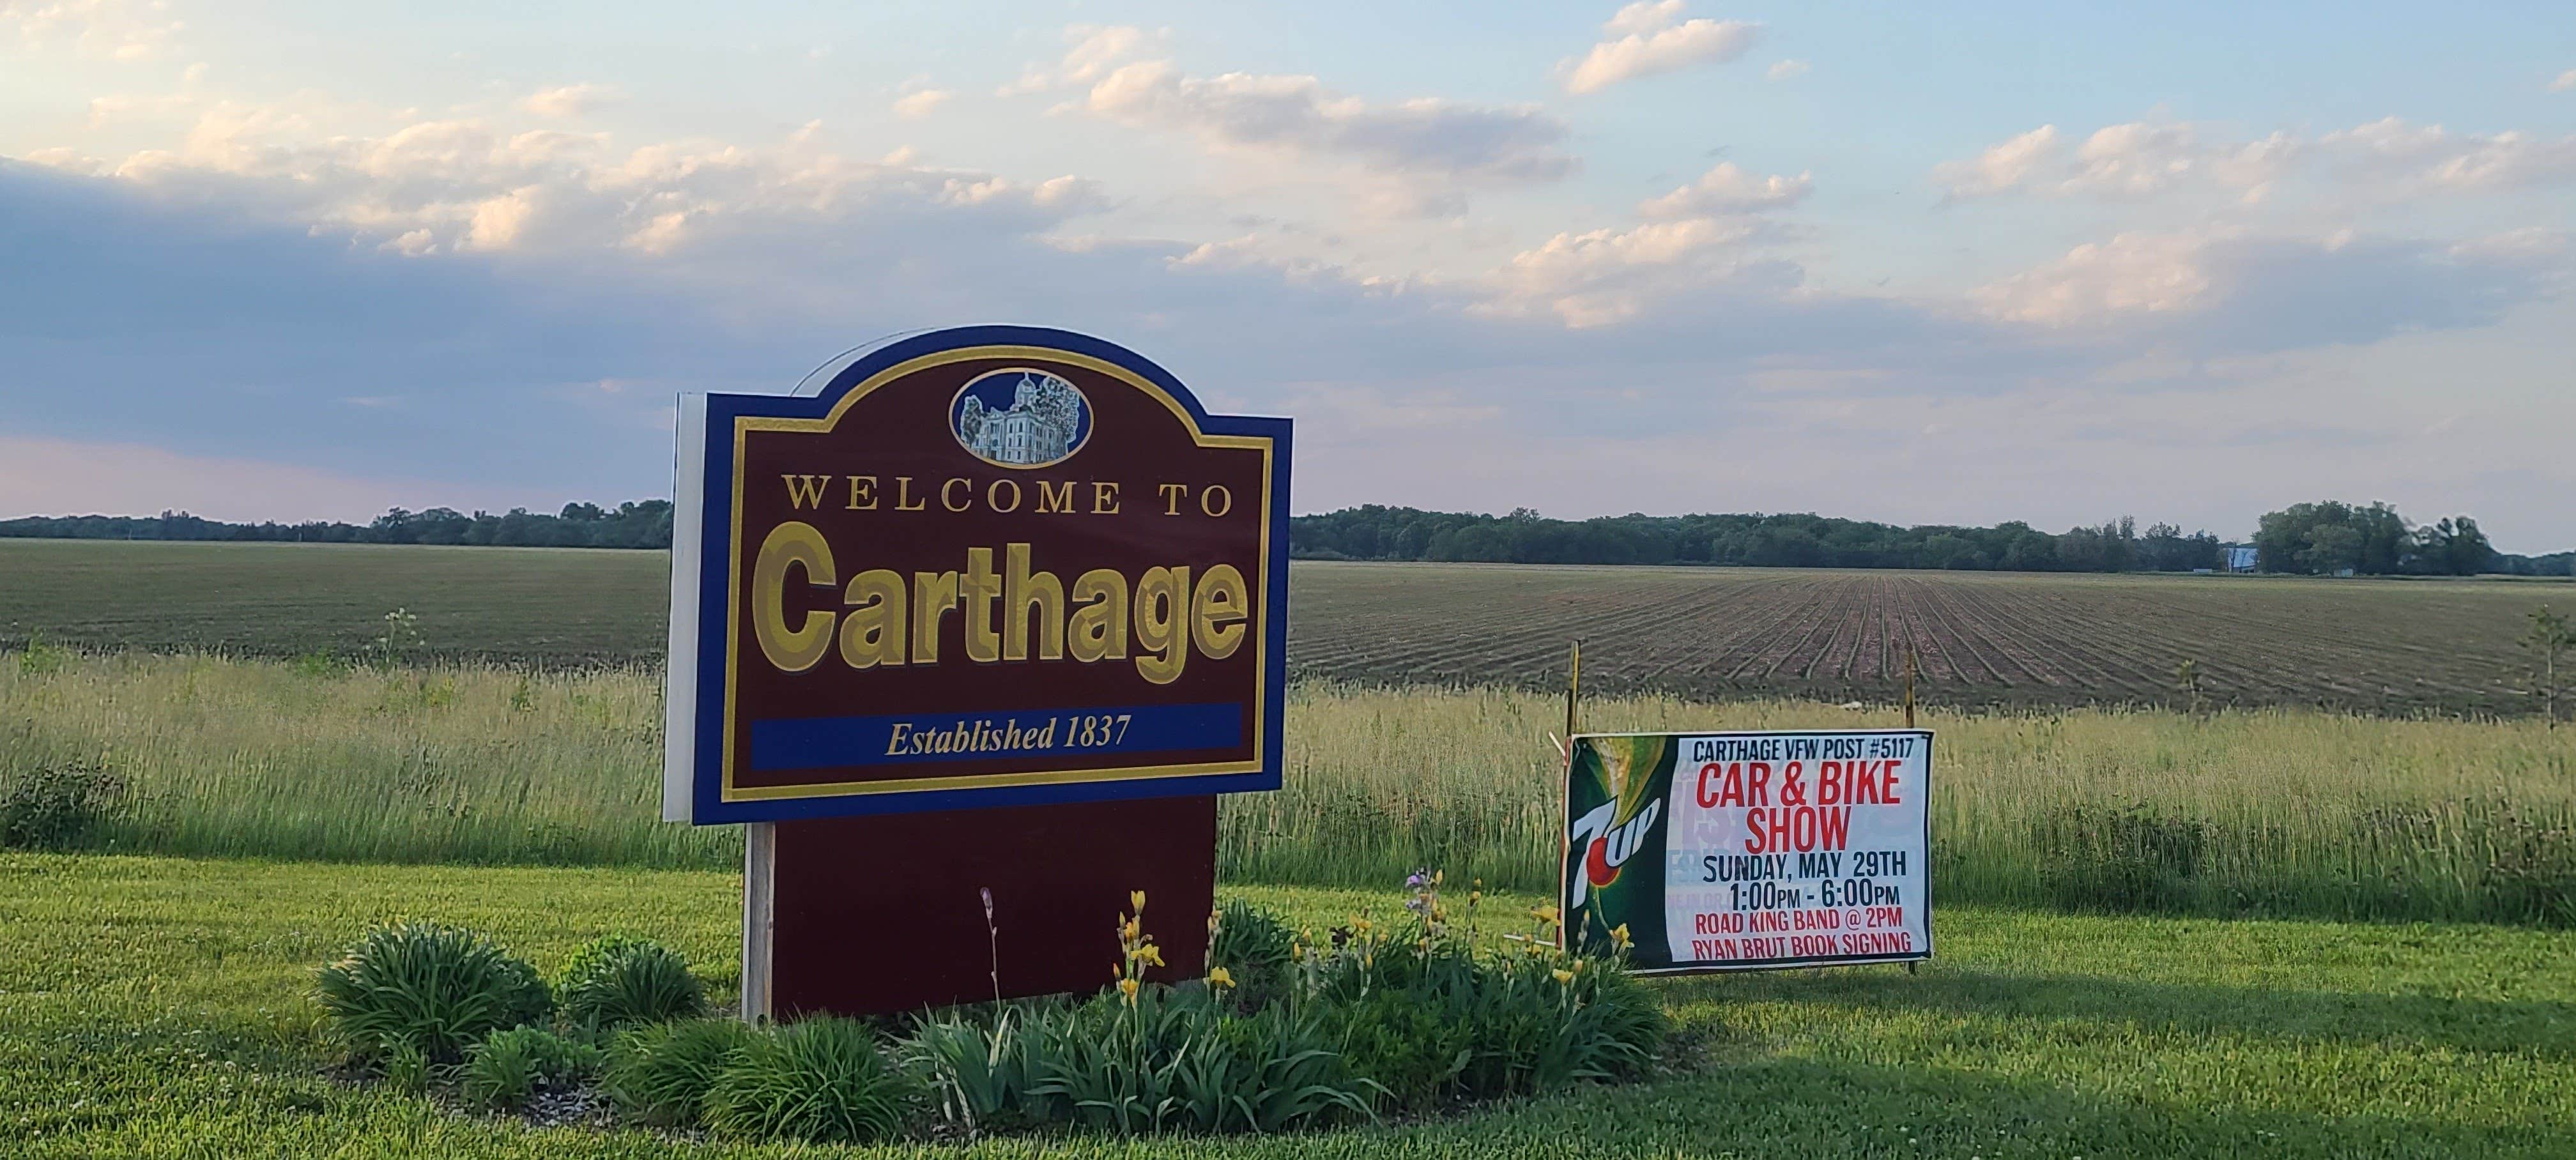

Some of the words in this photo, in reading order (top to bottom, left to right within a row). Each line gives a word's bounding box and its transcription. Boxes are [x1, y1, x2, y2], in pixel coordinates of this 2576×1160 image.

[781, 474, 1120, 515] WELCOME
[1160, 484, 1232, 517] TO
[751, 521, 1249, 686] Carthage
[884, 718, 1056, 756] Established
[1063, 714, 1131, 747] 1837
[1694, 739, 1781, 762] CARTHAGE
[1784, 738, 1820, 760] VFW
[1823, 738, 1865, 759] POST
[1869, 737, 1914, 759] #5117
[1696, 762, 1772, 809] CAR
[1780, 761, 1806, 806] &
[1818, 759, 1901, 805] BIKE
[1745, 805, 1851, 855] SHOW
[1703, 854, 1792, 883] SUNDAY,
[1798, 852, 1842, 879] MAY
[1853, 850, 1906, 878] 29TH
[1730, 881, 1801, 911] 1:00PM
[1821, 879, 1900, 908] 6:00PM
[1696, 913, 1744, 935] ROAD
[1749, 910, 1789, 933] KING
[1793, 909, 1840, 930] BAND
[1845, 909, 1861, 931] @
[1866, 907, 1902, 928] 2PM
[1692, 939, 1738, 960] RYAN
[1741, 936, 1785, 958] BRUT
[1791, 935, 1839, 956] BOOK
[1842, 931, 1912, 955] SIGNING
